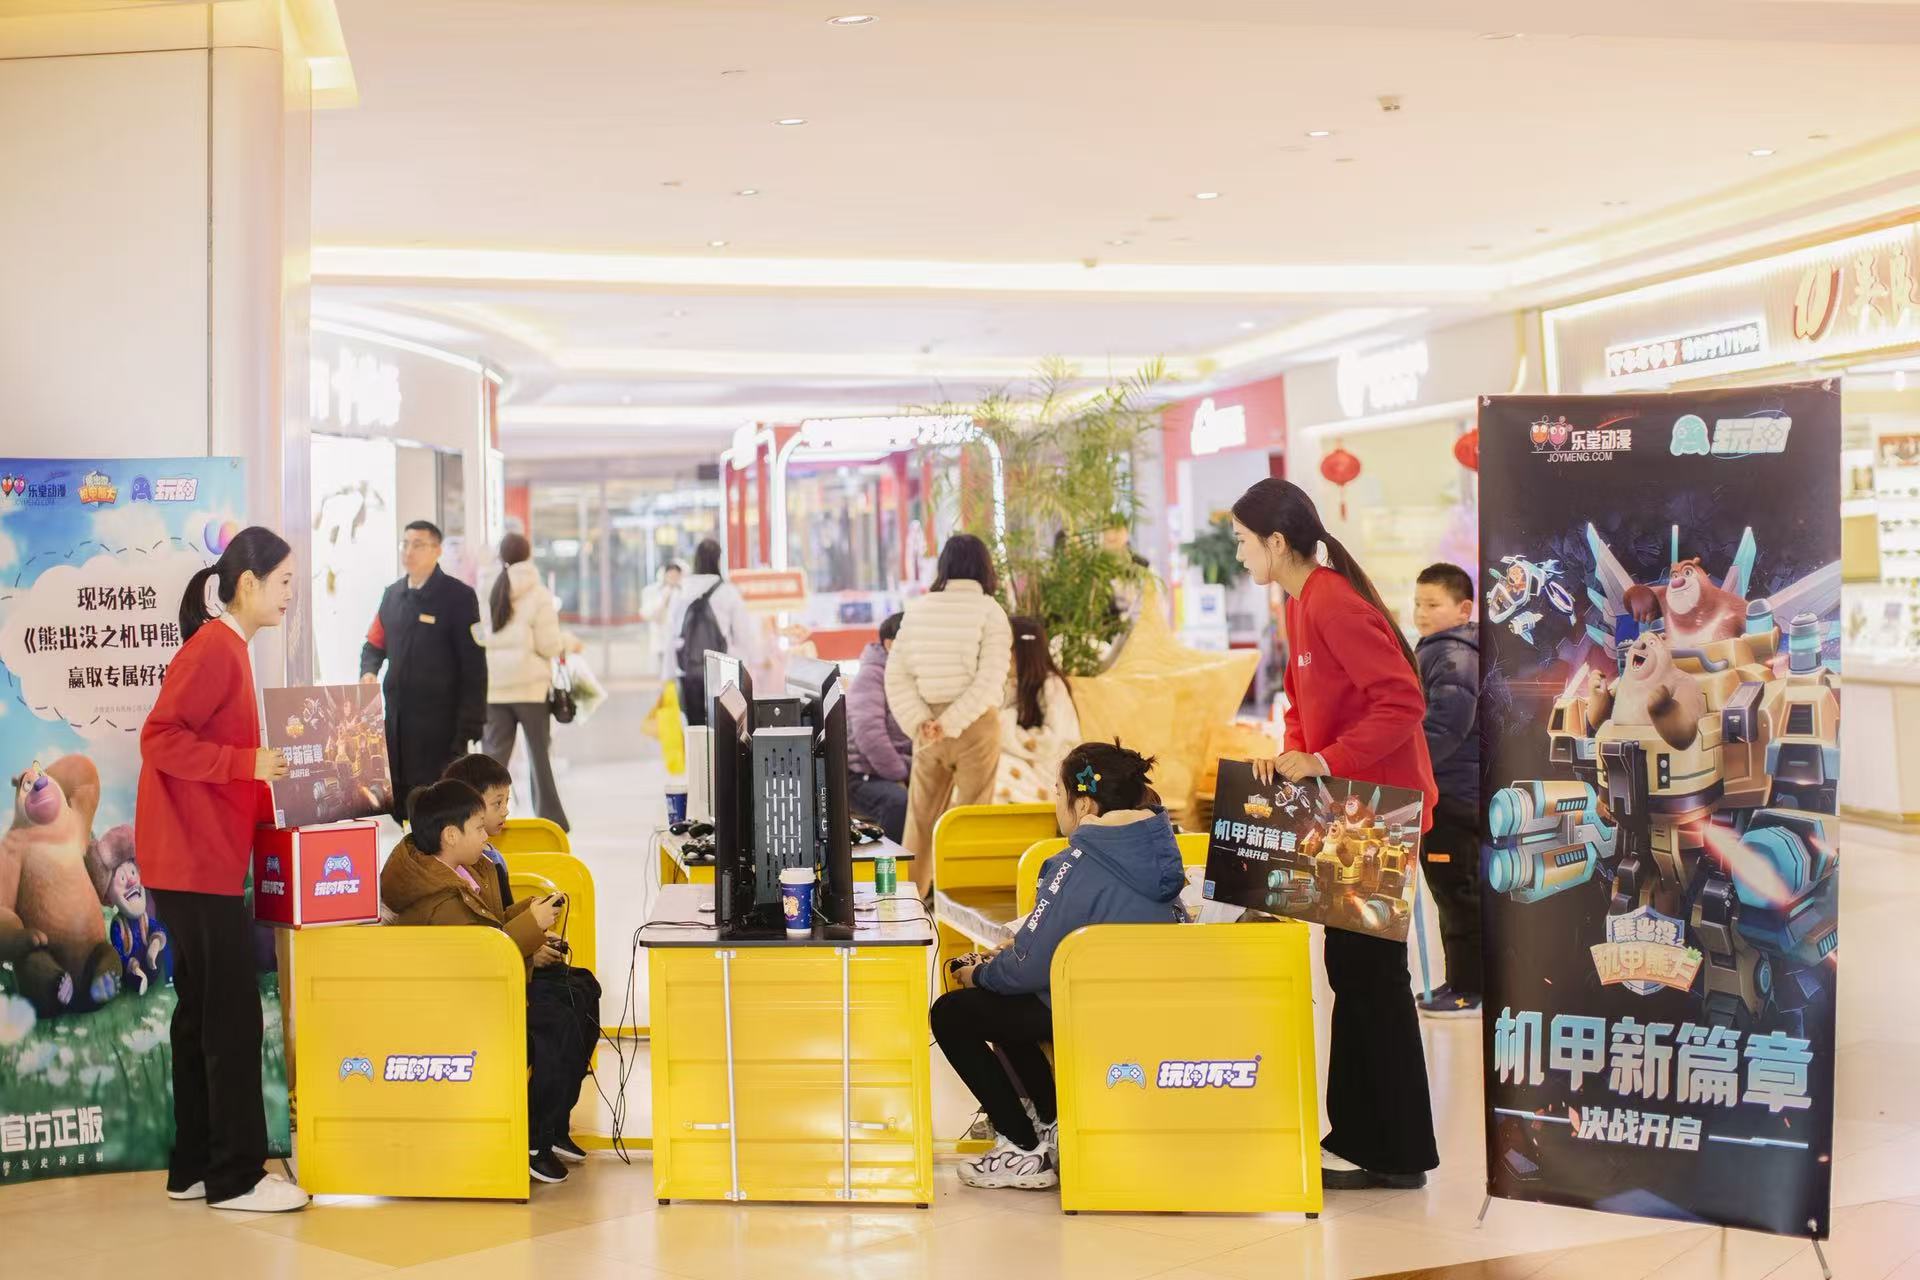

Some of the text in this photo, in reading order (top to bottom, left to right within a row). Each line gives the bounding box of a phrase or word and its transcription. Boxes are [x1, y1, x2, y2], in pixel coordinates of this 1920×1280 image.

[1571, 429, 1632, 450] 乐堂动漫
[1547, 452, 1613, 462] JOYMENG.COM
[77, 586, 157, 610] 现场体验
[282, 744, 324, 767] 甲新篇章
[1214, 818, 1297, 853] 机甲新篇章
[1237, 847, 1269, 861] 决战开启
[1613, 917, 1679, 945] 熊出没
[1495, 1007, 1813, 1112] 机甲新篇章
[0, 1106, 104, 1152] 官方正版
[1577, 1107, 1702, 1151] 决战开启
